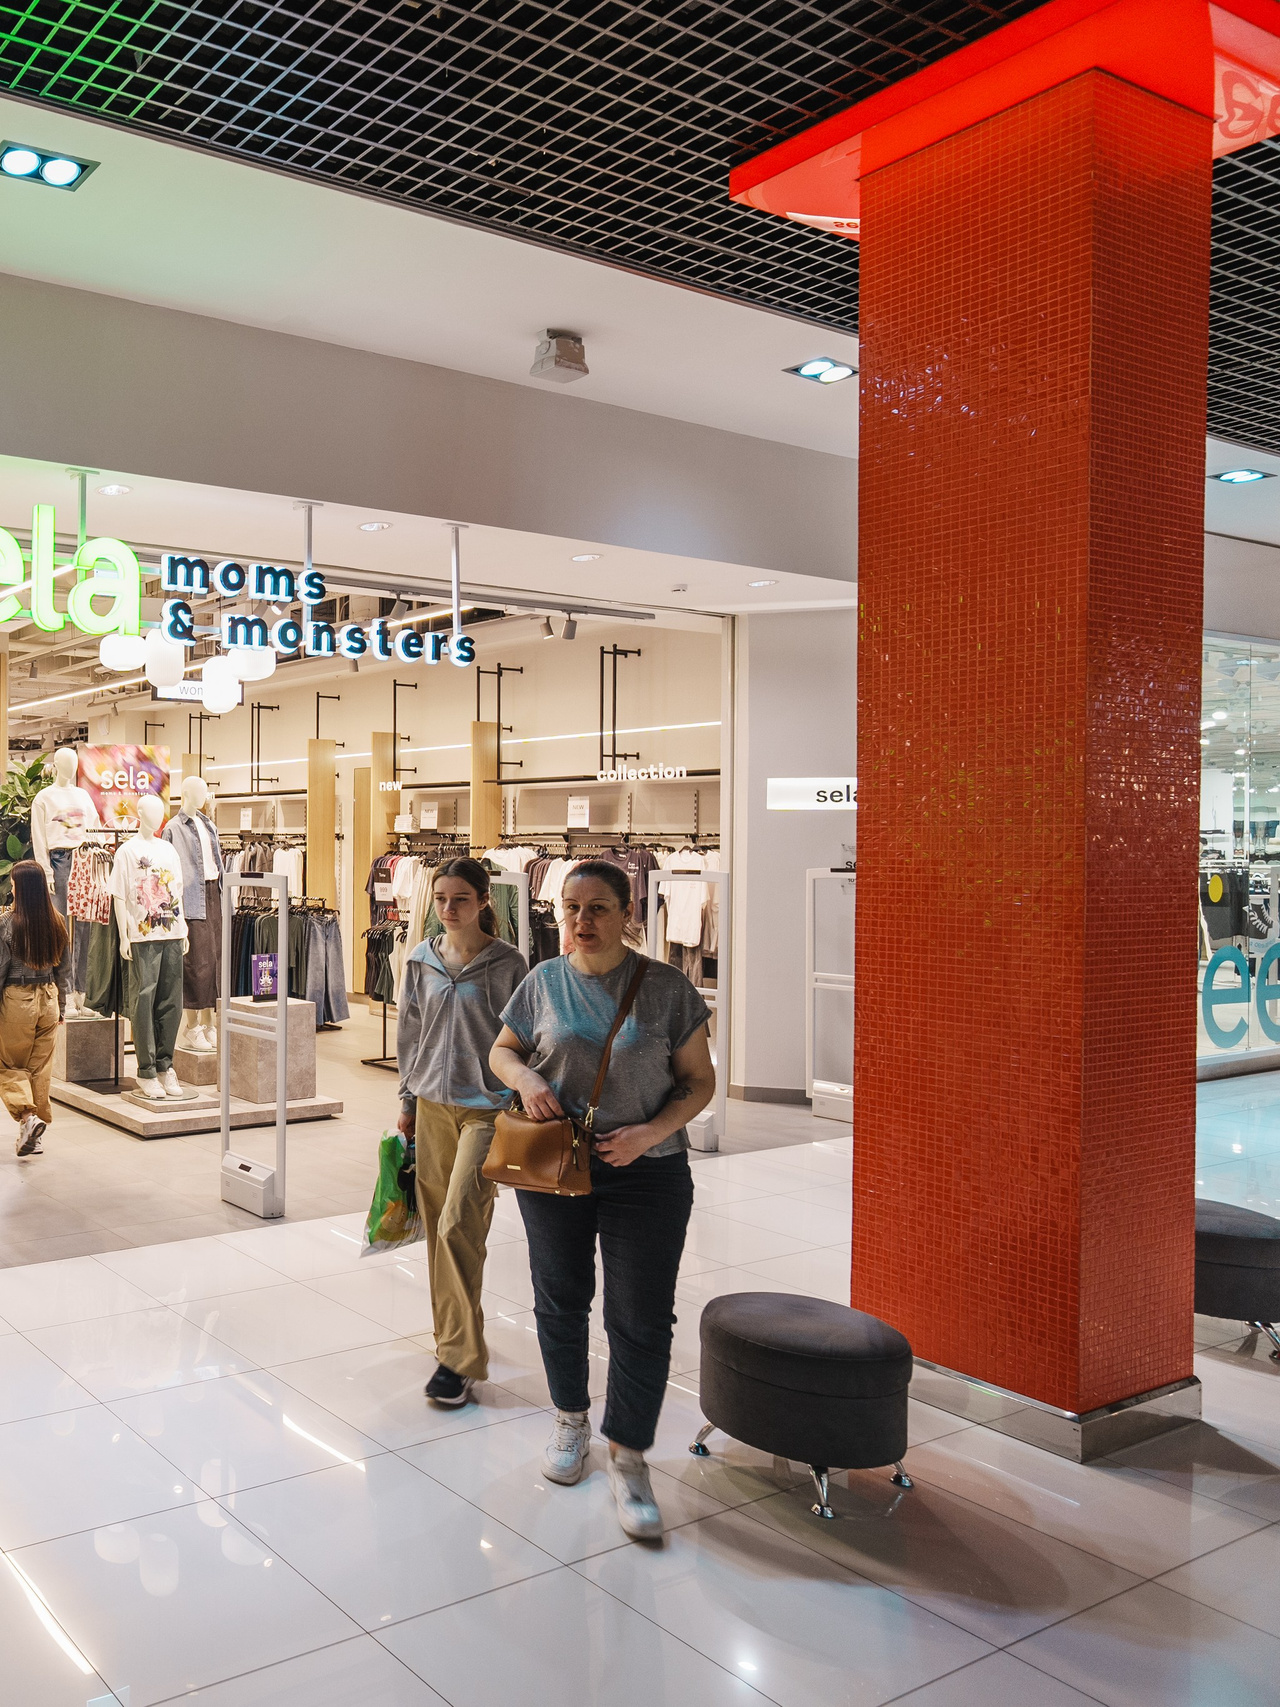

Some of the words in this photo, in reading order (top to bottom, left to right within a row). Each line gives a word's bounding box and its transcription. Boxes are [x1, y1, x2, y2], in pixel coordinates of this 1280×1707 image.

[160, 552, 326, 605] moms
[160, 598, 197, 645] &
[227, 611, 477, 667] monsters
[100, 766, 150, 790] sela
[596, 763, 687, 782] collection
[379, 780, 403, 792] new
[258, 959, 273, 968] sela
